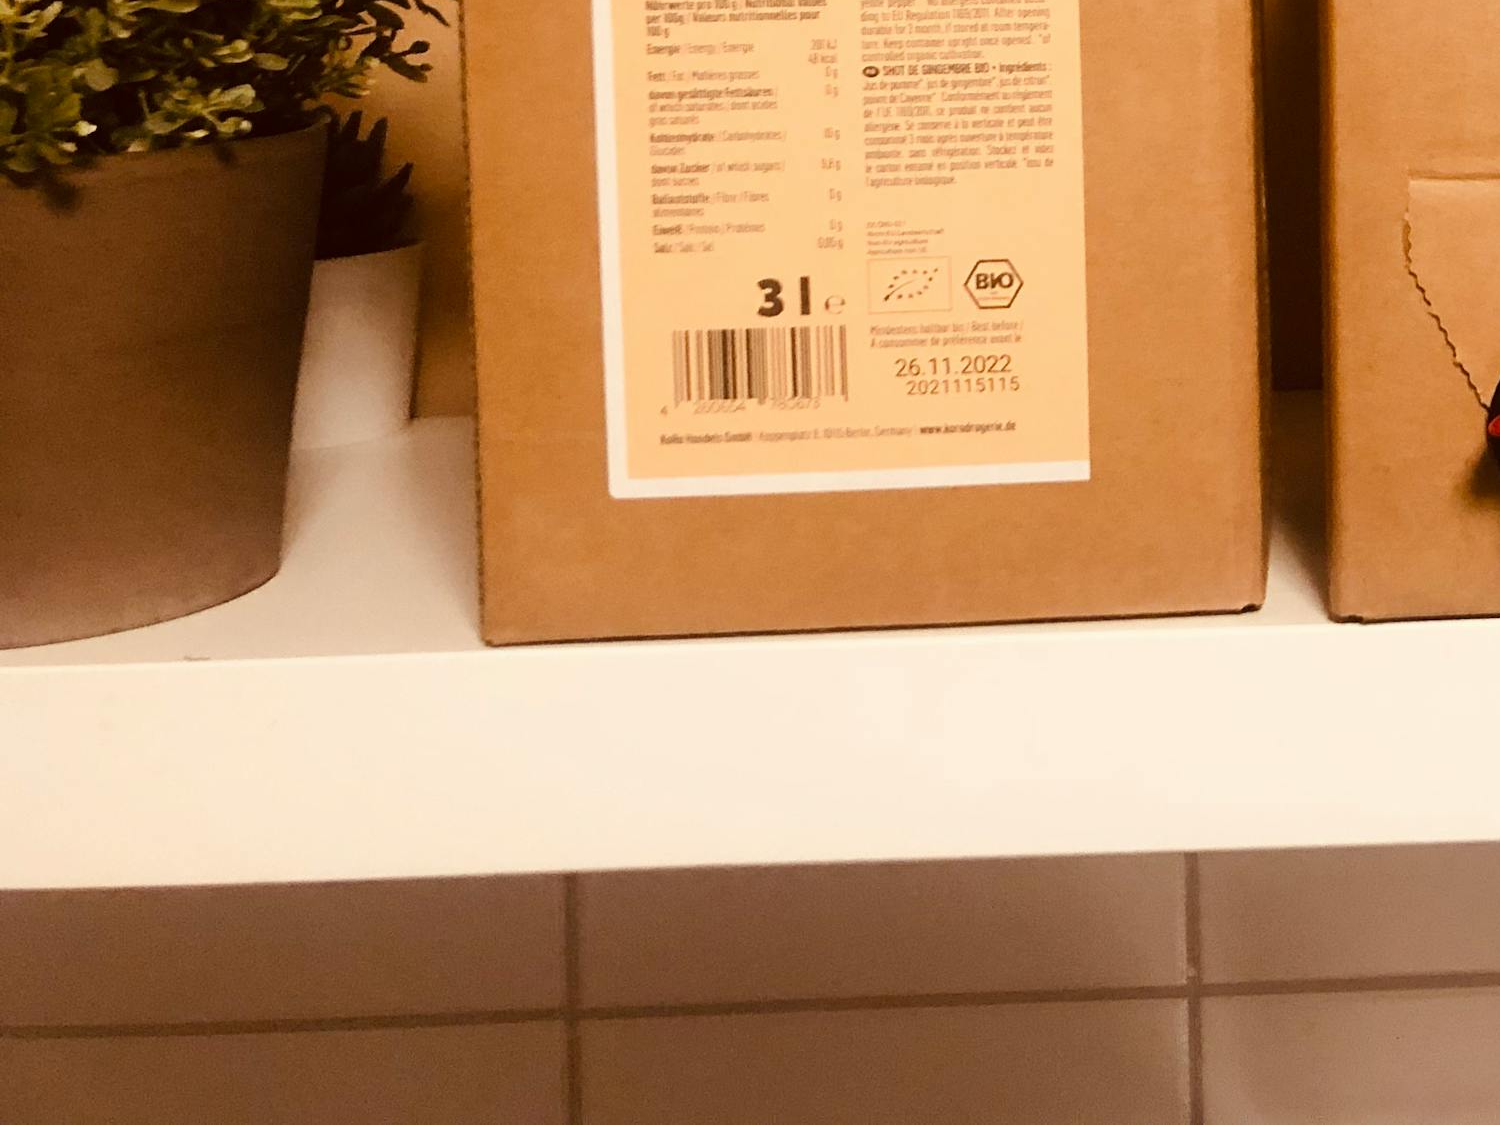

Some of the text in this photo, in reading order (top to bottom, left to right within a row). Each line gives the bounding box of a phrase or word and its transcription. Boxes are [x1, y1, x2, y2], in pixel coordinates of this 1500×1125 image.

[975, 270, 1013, 289] BIO
[758, 279, 784, 317] 3
[895, 355, 1012, 378] 26.11.2022
[907, 377, 1020, 395] 2021115115
